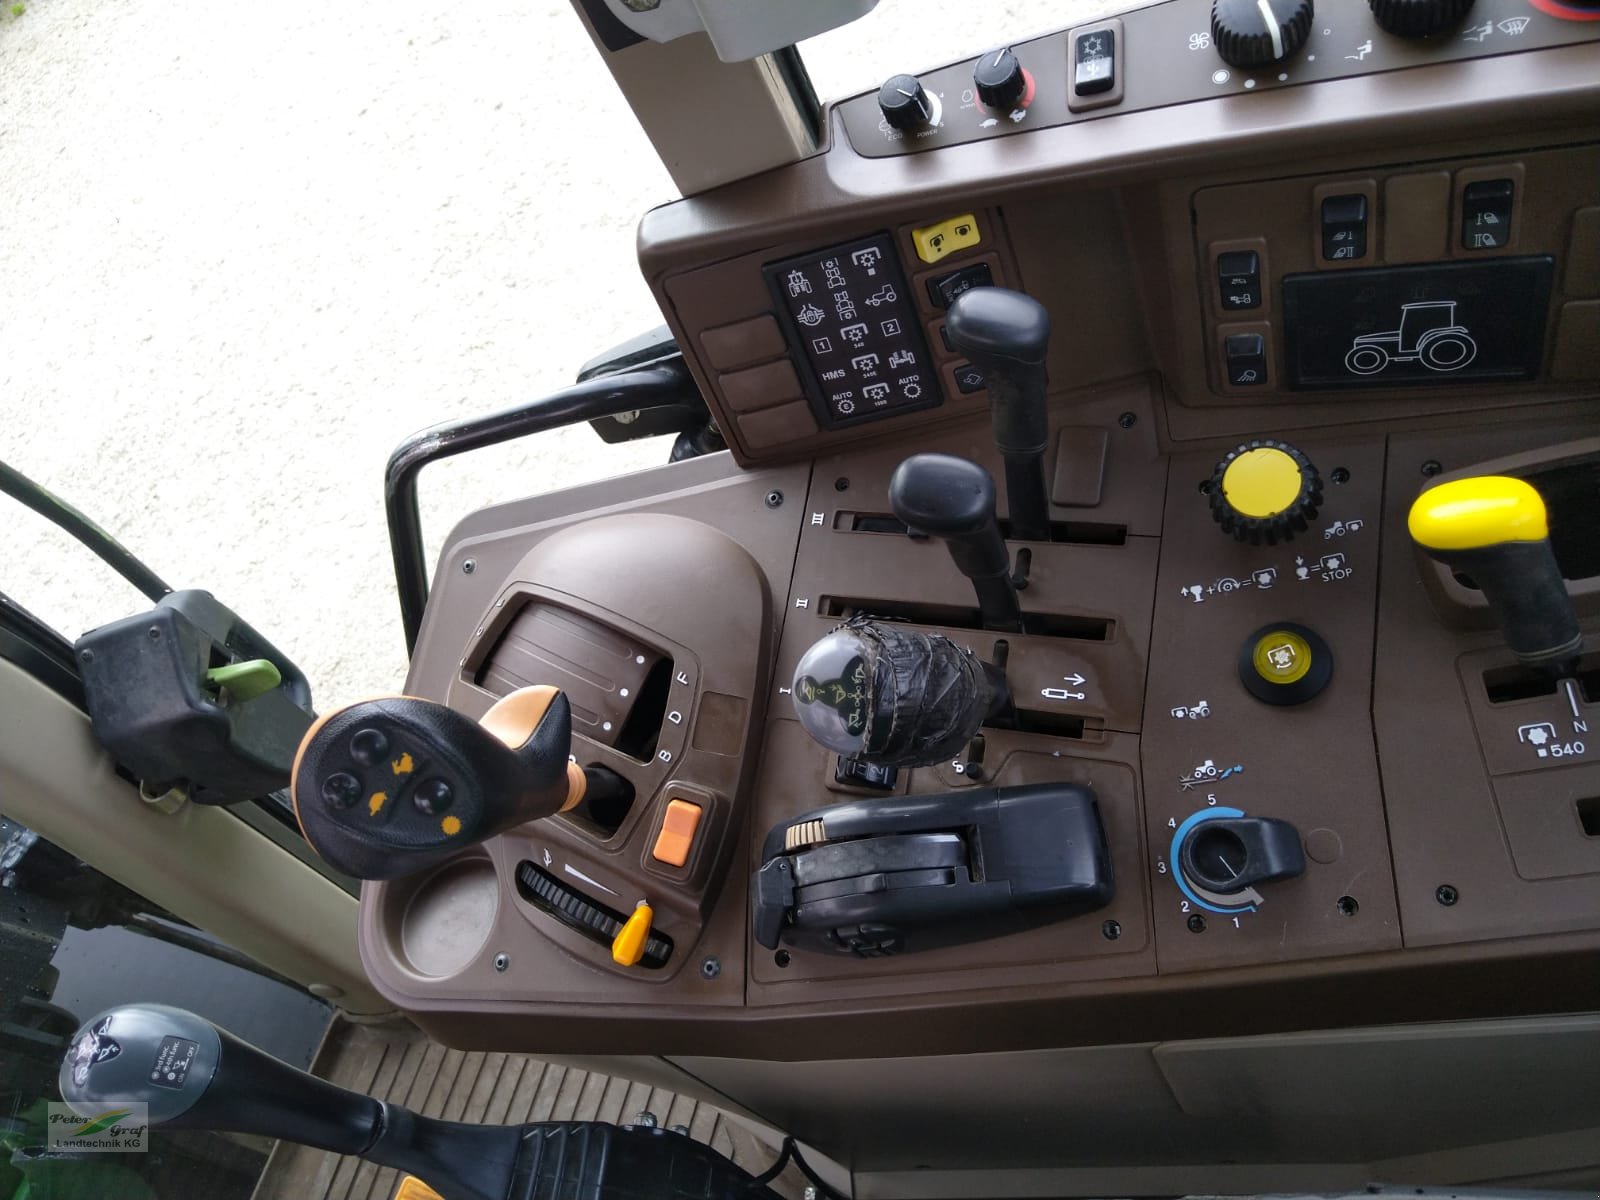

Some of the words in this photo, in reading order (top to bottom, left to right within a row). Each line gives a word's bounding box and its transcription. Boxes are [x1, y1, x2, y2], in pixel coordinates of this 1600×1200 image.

[887, 132, 903, 141] ECO
[916, 129, 938, 138] POWER
[886, 323, 895, 332] 2
[818, 341, 826, 350] 1
[822, 369, 846, 381] HMS
[898, 374, 920, 385] AUTO
[832, 391, 853, 401] AUTO
[1321, 567, 1353, 582] STOP
[676, 671, 688, 685] F
[668, 711, 682, 724] D
[1573, 720, 1588, 733] N
[1550, 741, 1585, 757] 540
[658, 750, 672, 763] B
[1207, 793, 1217, 805] 5
[1168, 817, 1177, 828] 4
[1157, 861, 1167, 874] 3
[1180, 901, 1190, 913] 2
[1231, 917, 1240, 929] 1
